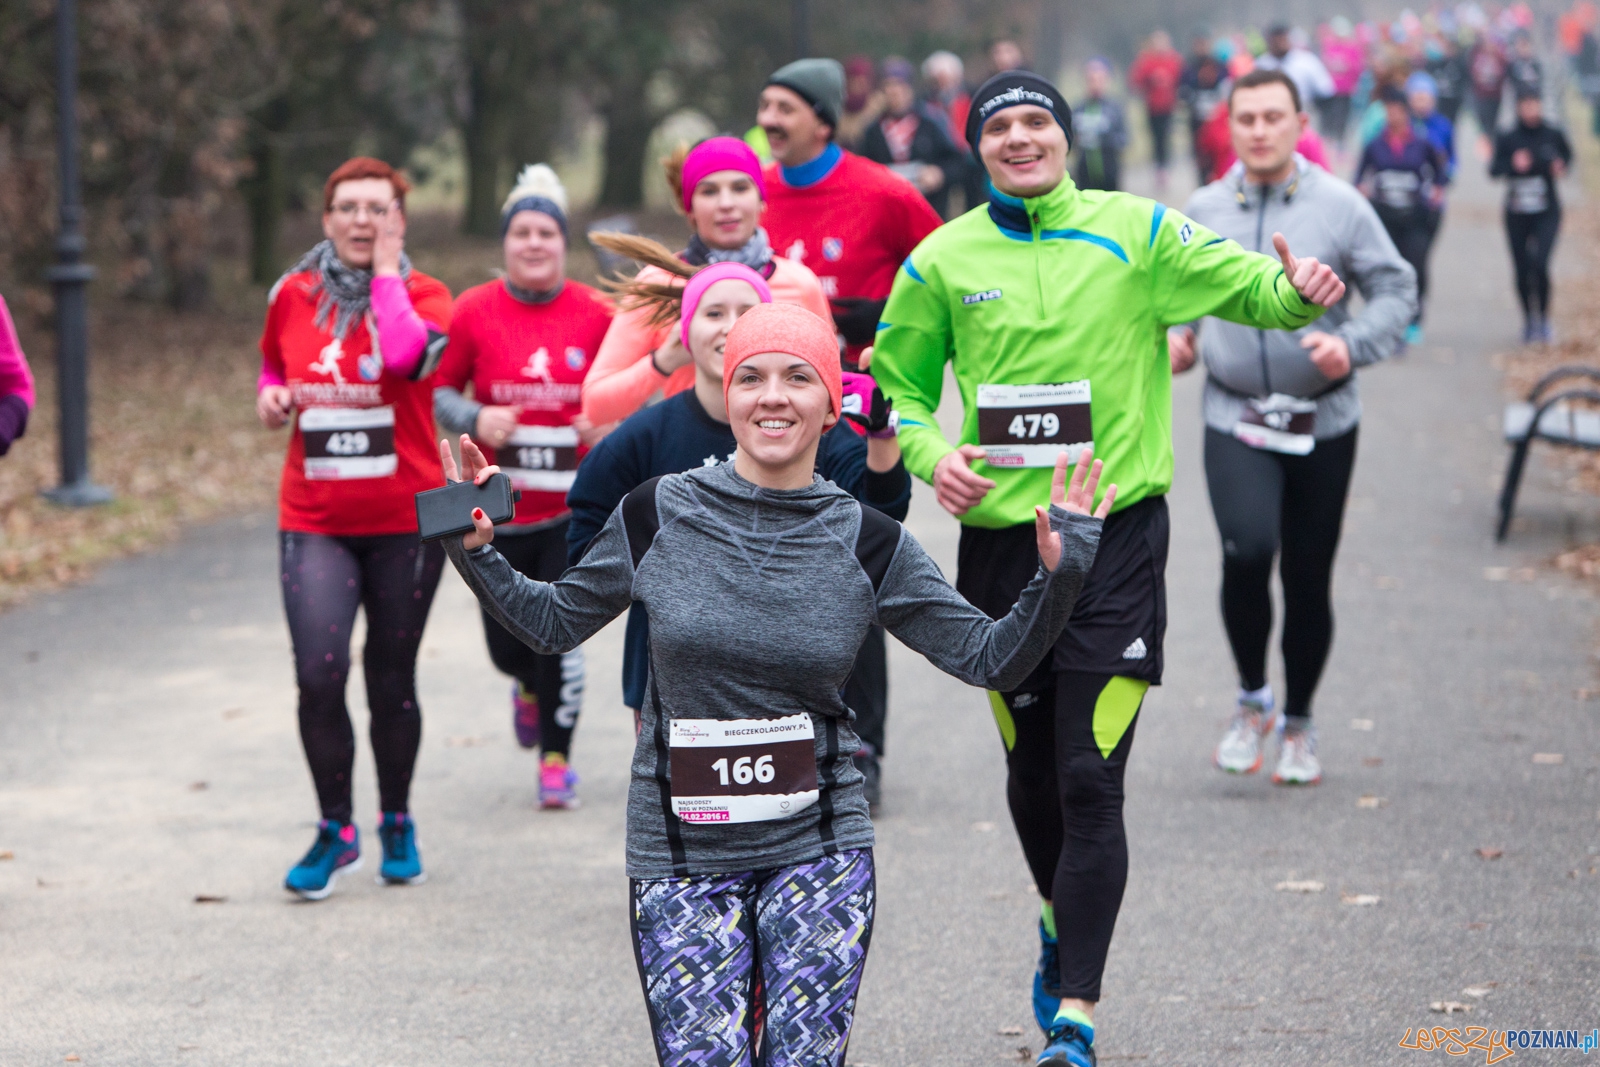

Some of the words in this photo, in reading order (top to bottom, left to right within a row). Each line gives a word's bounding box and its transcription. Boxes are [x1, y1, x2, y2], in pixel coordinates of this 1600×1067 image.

[1008, 412, 1060, 438] 479
[325, 431, 370, 455] 429
[517, 447, 556, 470] 151
[724, 723, 808, 737] BIEGCZEKOLADOWY.PL
[711, 754, 775, 786] 166
[680, 812, 721, 820] 14.02.2016
